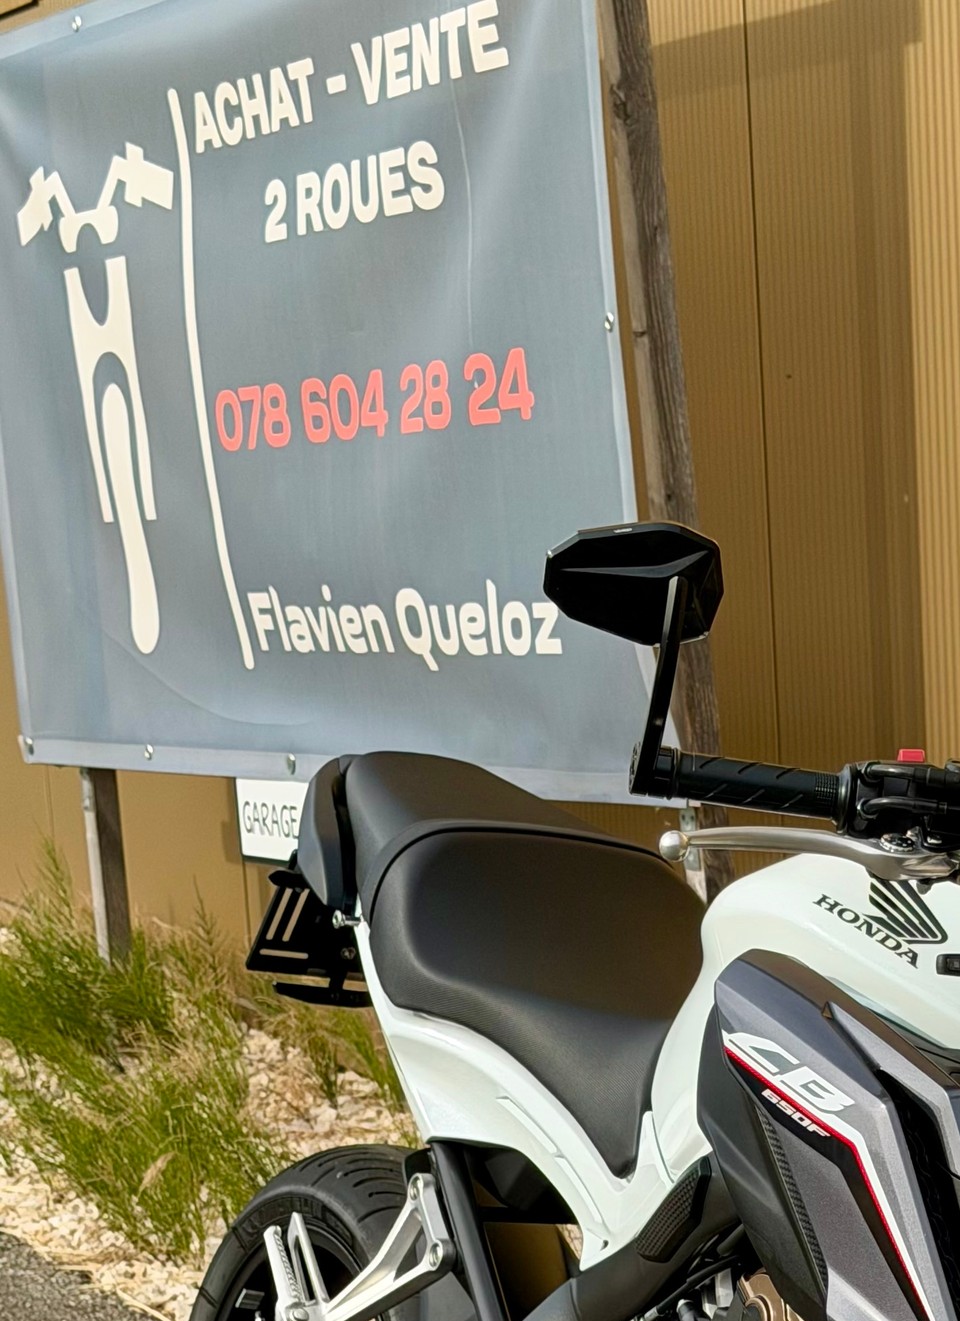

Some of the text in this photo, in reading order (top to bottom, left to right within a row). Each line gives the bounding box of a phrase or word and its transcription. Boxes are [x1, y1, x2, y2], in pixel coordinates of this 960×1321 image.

[194, 57, 315, 154] ACHAT
[350, 0, 509, 105] VENTE
[264, 140, 445, 243] 2 ROUES
[215, 347, 535, 452] 078 604 28 24
[247, 579, 562, 672] Flavien Queloz
[242, 800, 299, 839] GARAGE
[812, 893, 919, 969] HONDA
[722, 1030, 856, 1112] CB
[761, 1088, 832, 1137] 650F
